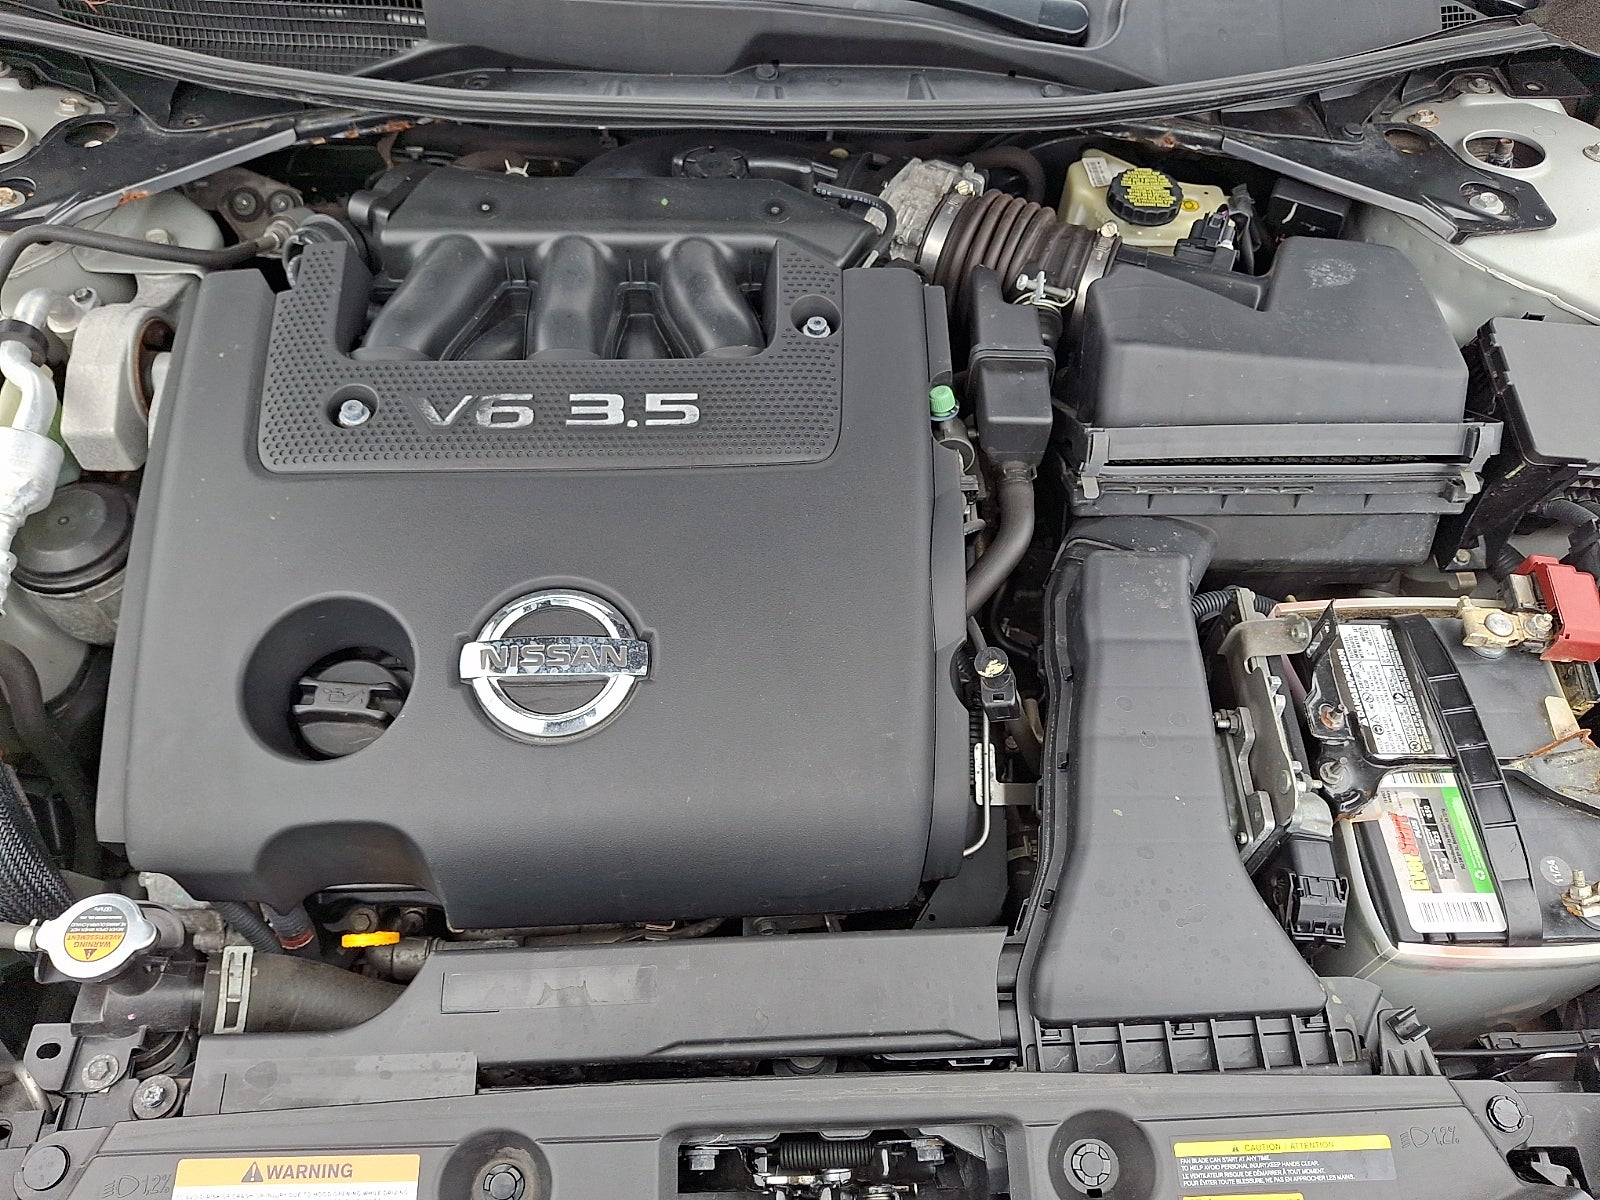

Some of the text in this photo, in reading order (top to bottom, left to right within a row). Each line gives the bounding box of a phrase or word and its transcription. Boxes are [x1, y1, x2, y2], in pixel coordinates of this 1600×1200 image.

[414, 393, 700, 428] V6 3.5
[480, 644, 628, 670] NISSAN
[1245, 1142, 1282, 1152] CAUTION
[1290, 1140, 1334, 1150] ATTENTION
[266, 1163, 353, 1180] WARNING
[143, 1174, 172, 1196] 1,2%
